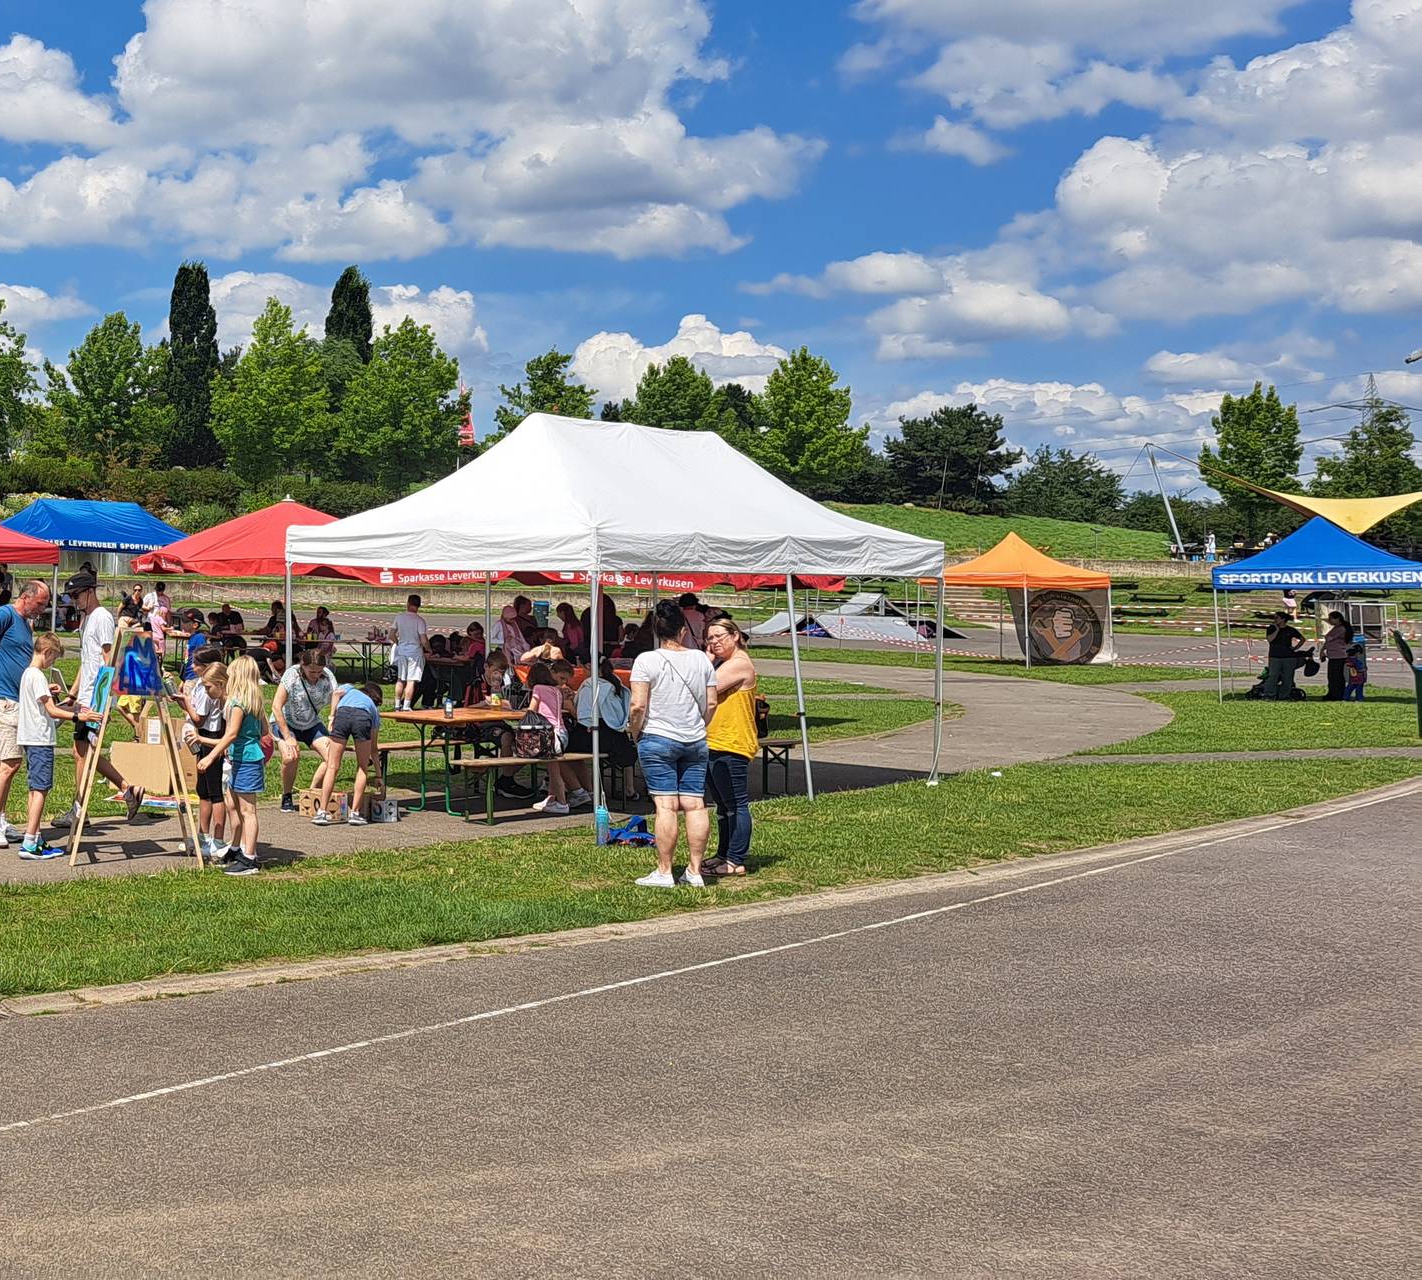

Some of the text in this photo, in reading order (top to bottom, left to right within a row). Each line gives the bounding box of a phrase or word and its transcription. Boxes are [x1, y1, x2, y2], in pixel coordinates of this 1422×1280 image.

[68, 539, 117, 549] LEVERKUSEN
[398, 573, 445, 585] Sparkasse
[579, 572, 632, 585] Sprkasse
[635, 574, 694, 589] Levrkusen
[1219, 571, 1422, 585] SPORTPARK LEVERKUSEN
